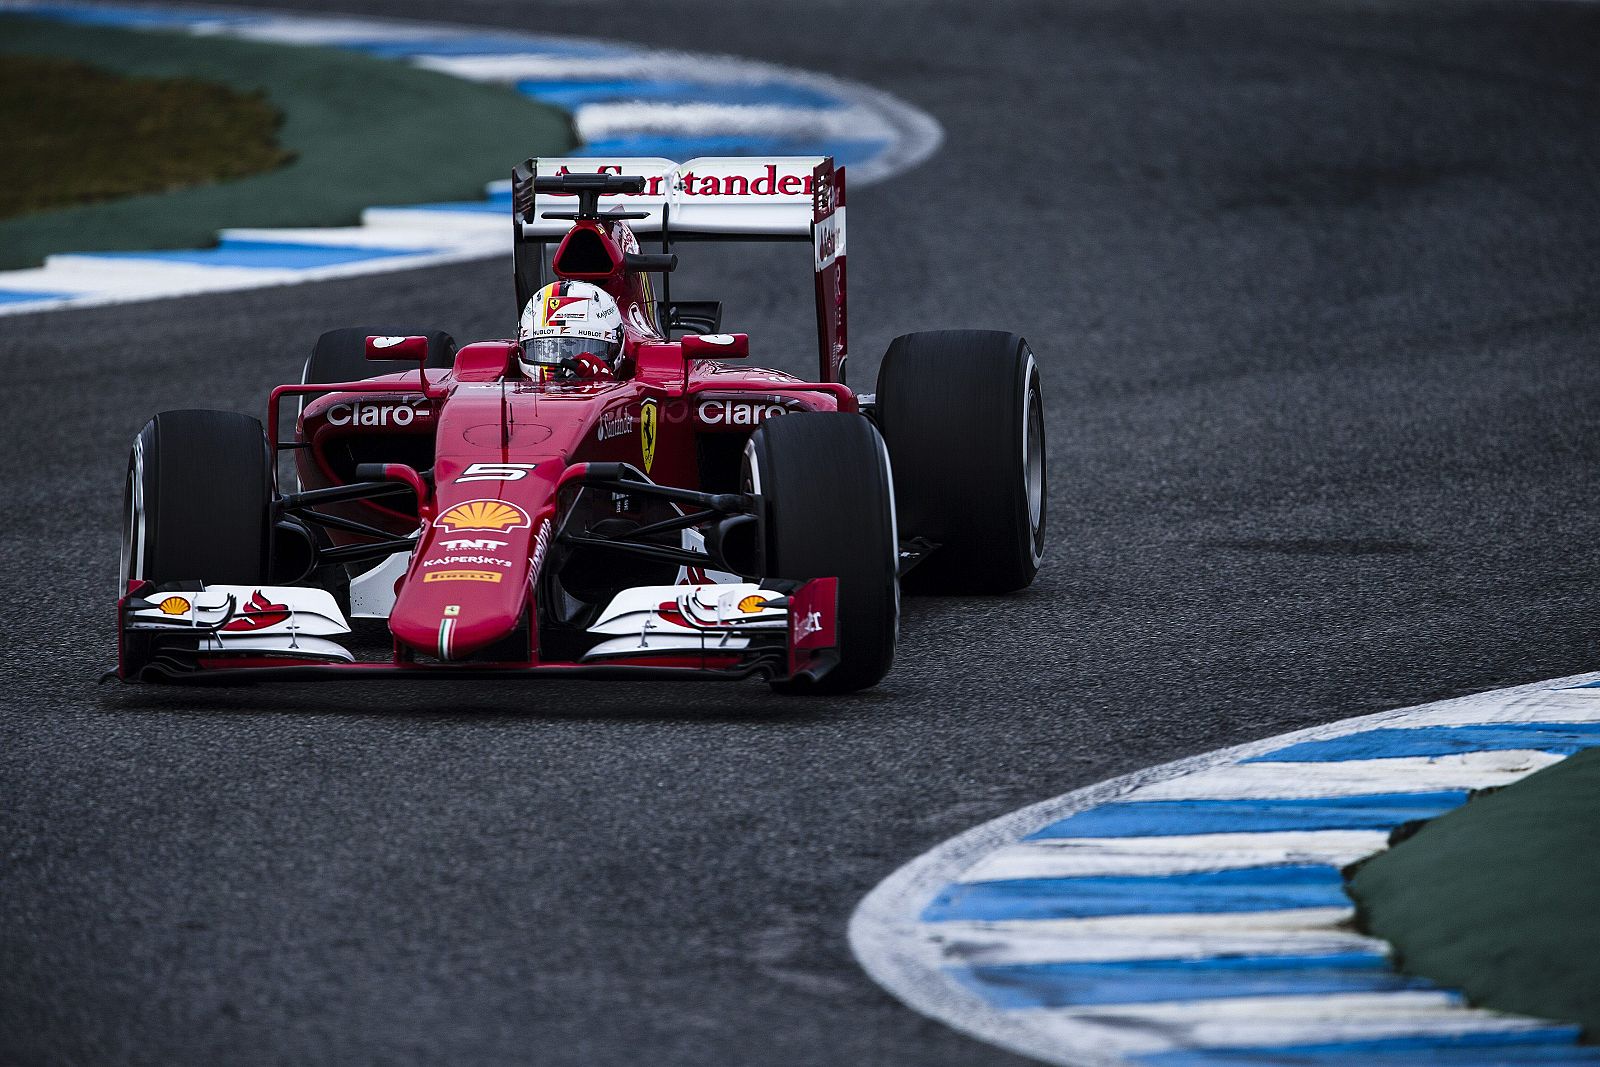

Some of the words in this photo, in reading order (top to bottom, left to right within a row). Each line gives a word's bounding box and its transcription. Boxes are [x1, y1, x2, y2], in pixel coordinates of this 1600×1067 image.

[326, 402, 415, 426] Claro
[454, 463, 536, 483] 5
[438, 539, 509, 550] TNT
